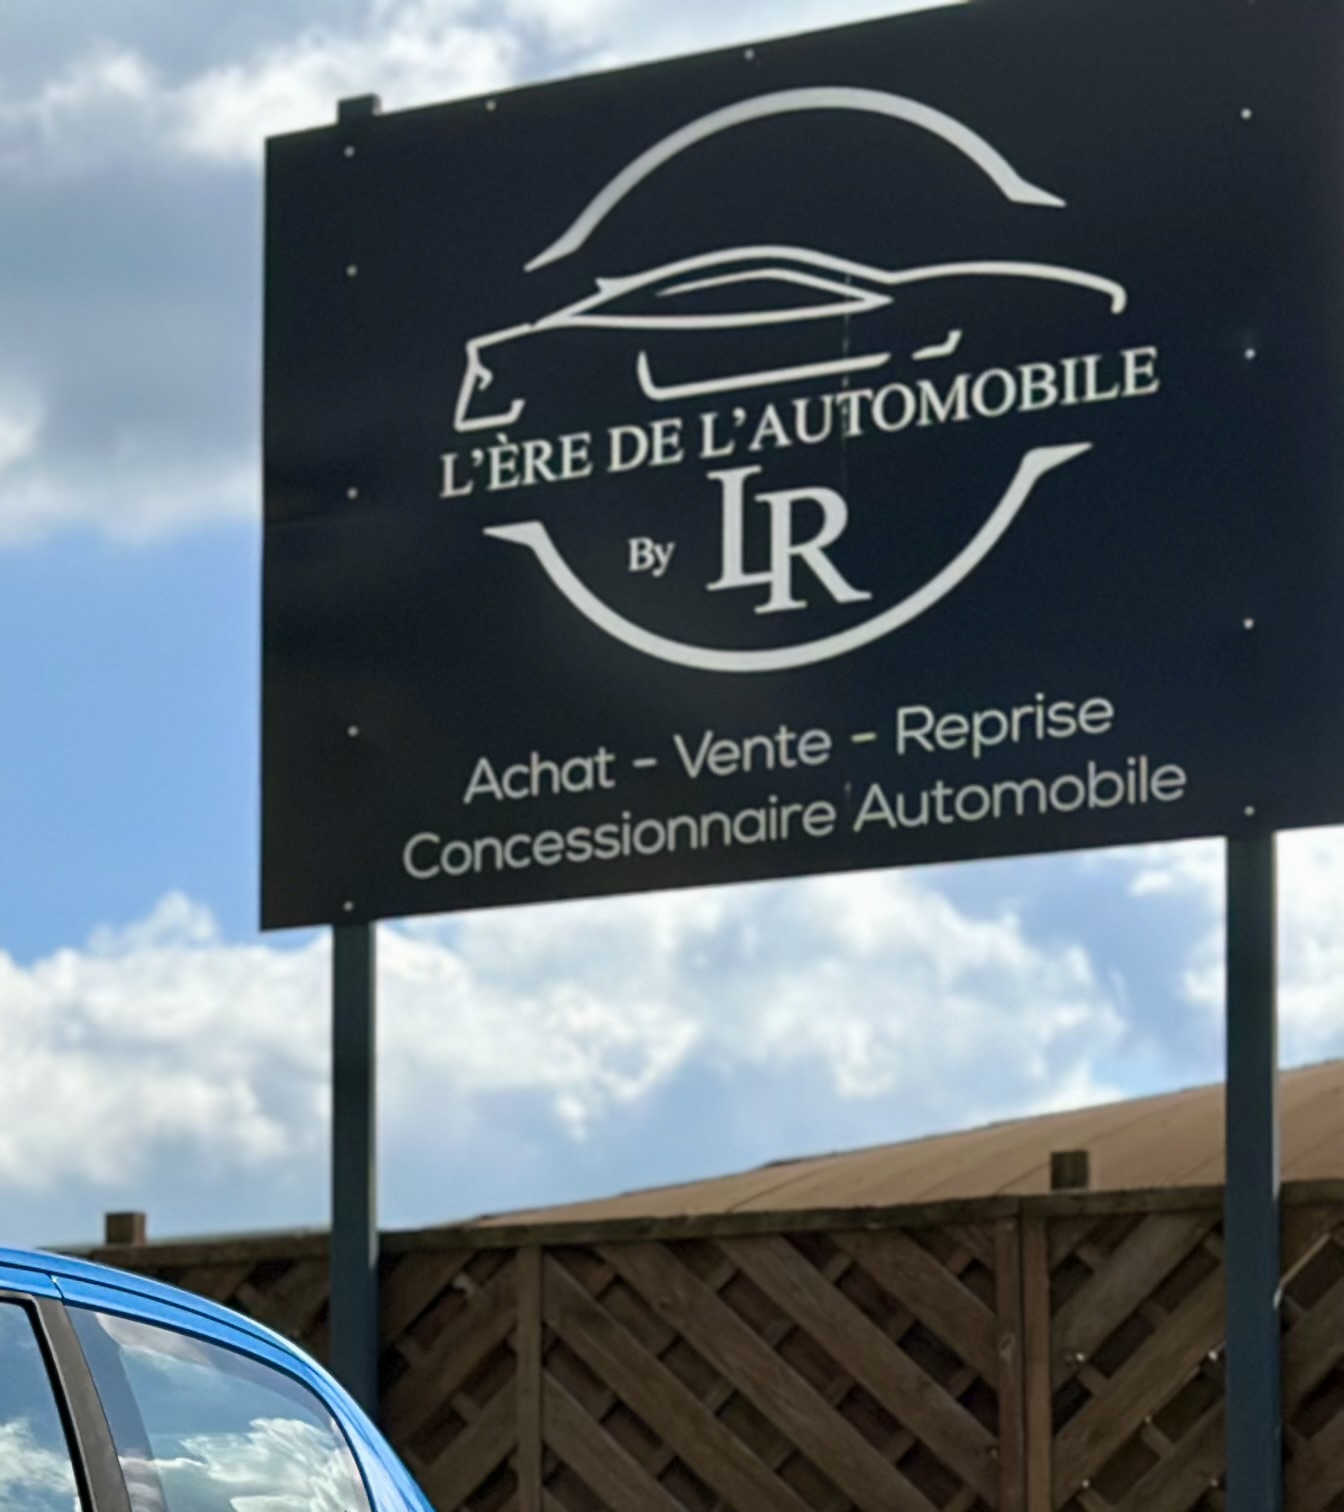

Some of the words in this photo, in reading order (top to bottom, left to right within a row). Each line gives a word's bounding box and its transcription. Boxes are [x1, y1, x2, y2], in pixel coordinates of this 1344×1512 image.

[440, 432, 593, 498] L'ÈRE
[607, 417, 685, 472] DE
[700, 346, 1160, 459] L'AUTOMOBILE
[628, 537, 675, 577] By
[705, 464, 872, 615] LR
[463, 746, 615, 804] Achat
[673, 725, 833, 779] Vente
[896, 692, 1115, 760] Reprise
[402, 795, 837, 880] Concessionnaire
[853, 755, 1188, 833] Automobile
